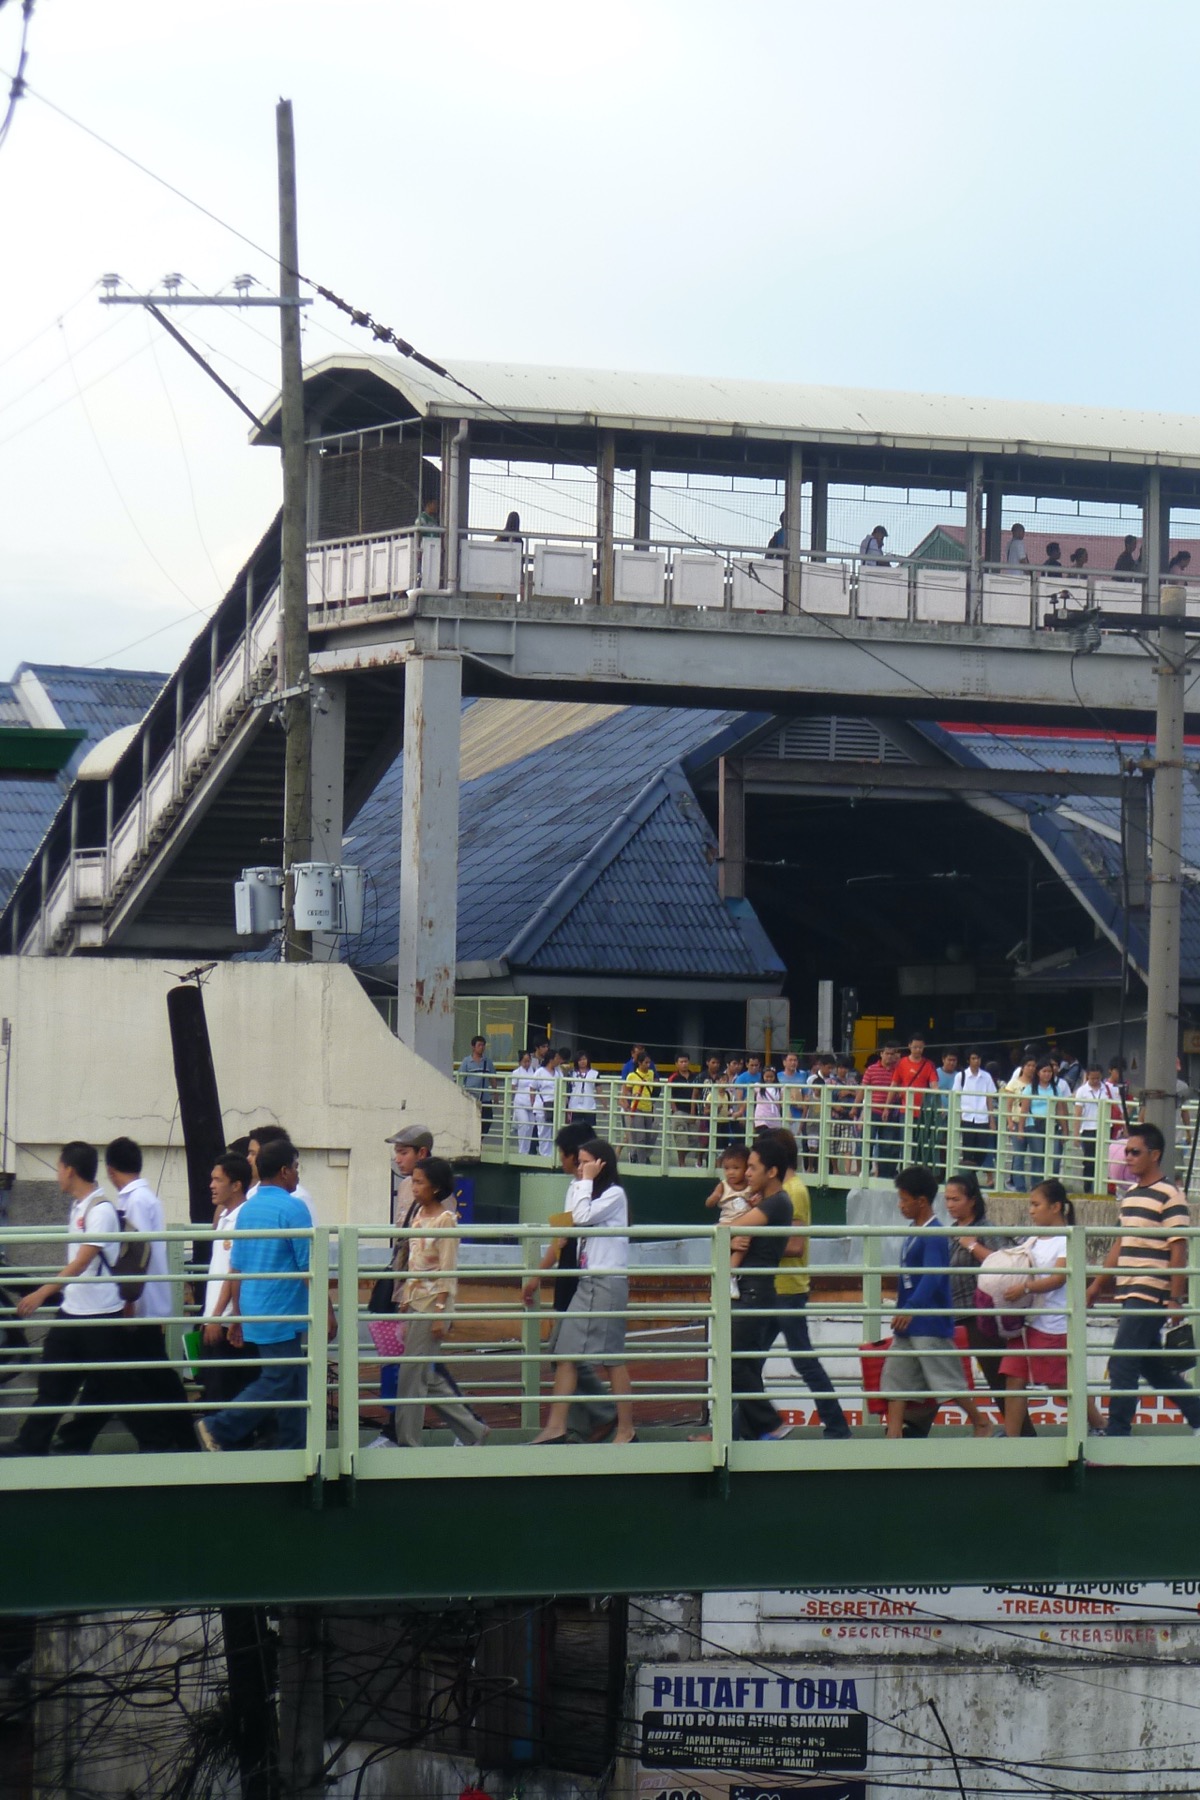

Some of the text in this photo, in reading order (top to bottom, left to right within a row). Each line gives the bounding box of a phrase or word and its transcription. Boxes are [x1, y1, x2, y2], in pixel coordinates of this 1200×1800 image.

[837, 1626, 932, 1639] SECRETARY
[1060, 1628, 1157, 1643] TREASURER
[653, 1676, 859, 1710] PILTAFT TODA
[663, 1713, 695, 1726] DITO
[697, 1714, 716, 1726] PO
[718, 1714, 744, 1727] ANG
[791, 1714, 849, 1728] SAKAYAN
[686, 1735, 710, 1745] JAPAN
[782, 1758, 815, 1768] MAKATI
